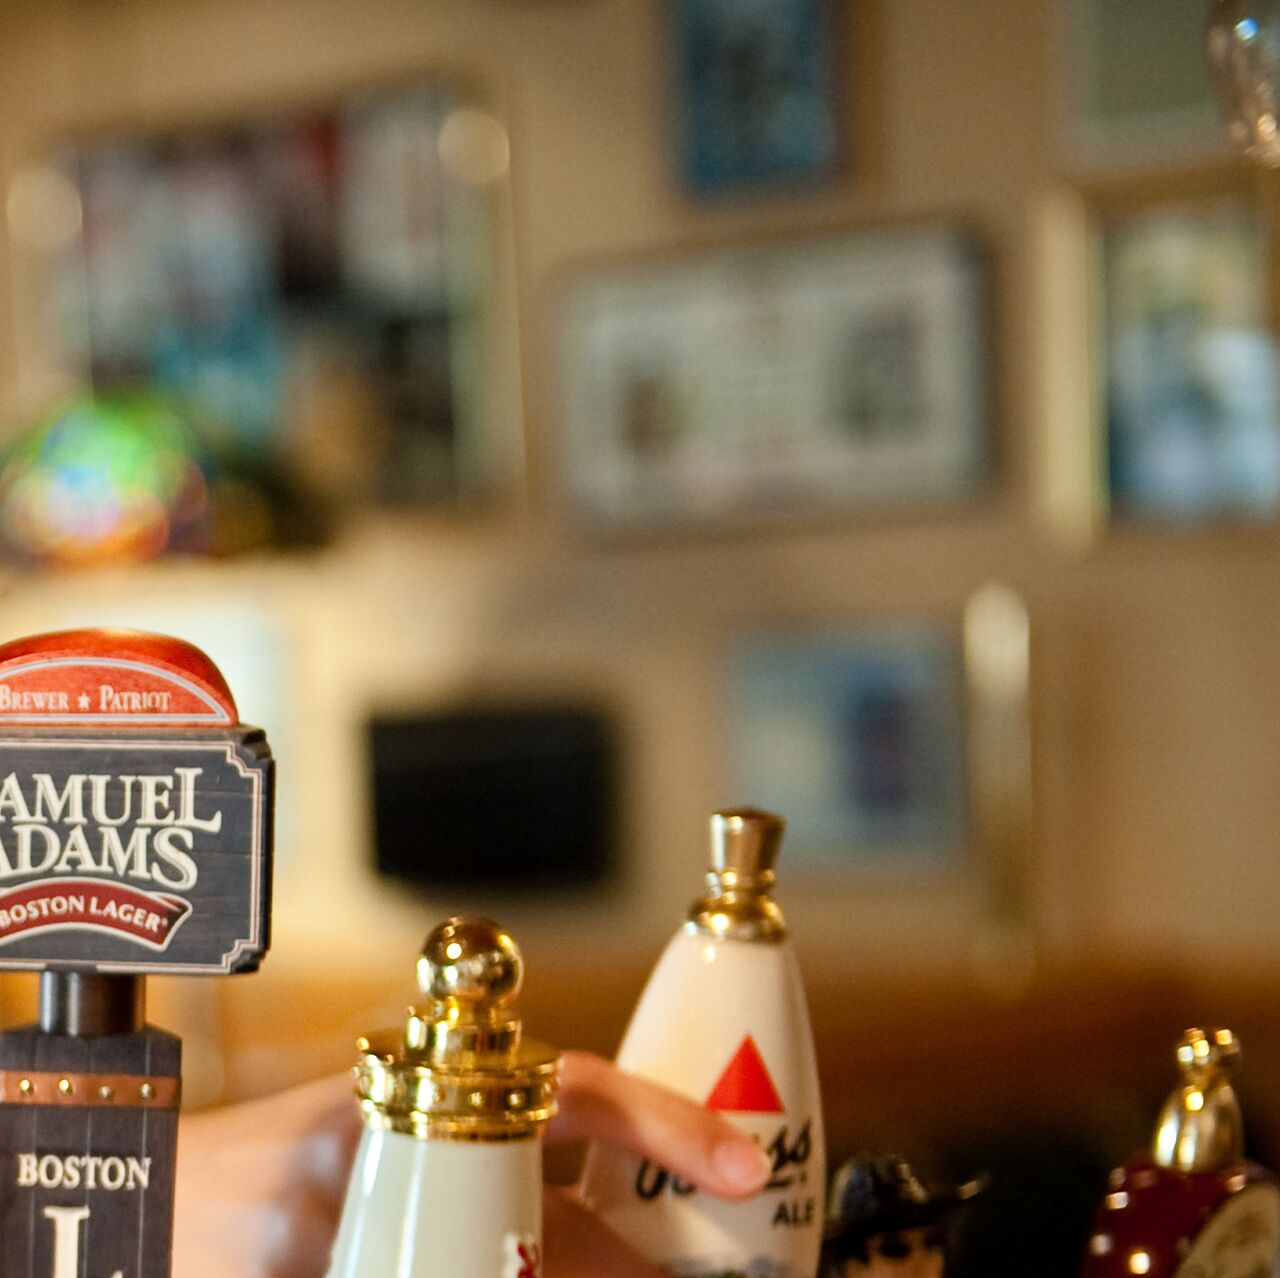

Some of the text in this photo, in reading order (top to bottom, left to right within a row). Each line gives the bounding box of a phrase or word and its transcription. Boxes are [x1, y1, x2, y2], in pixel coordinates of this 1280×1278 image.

[99, 684, 171, 711] PATRIOT
[90, 897, 162, 932] LAGER
[17, 1153, 152, 1190] BOSTON
